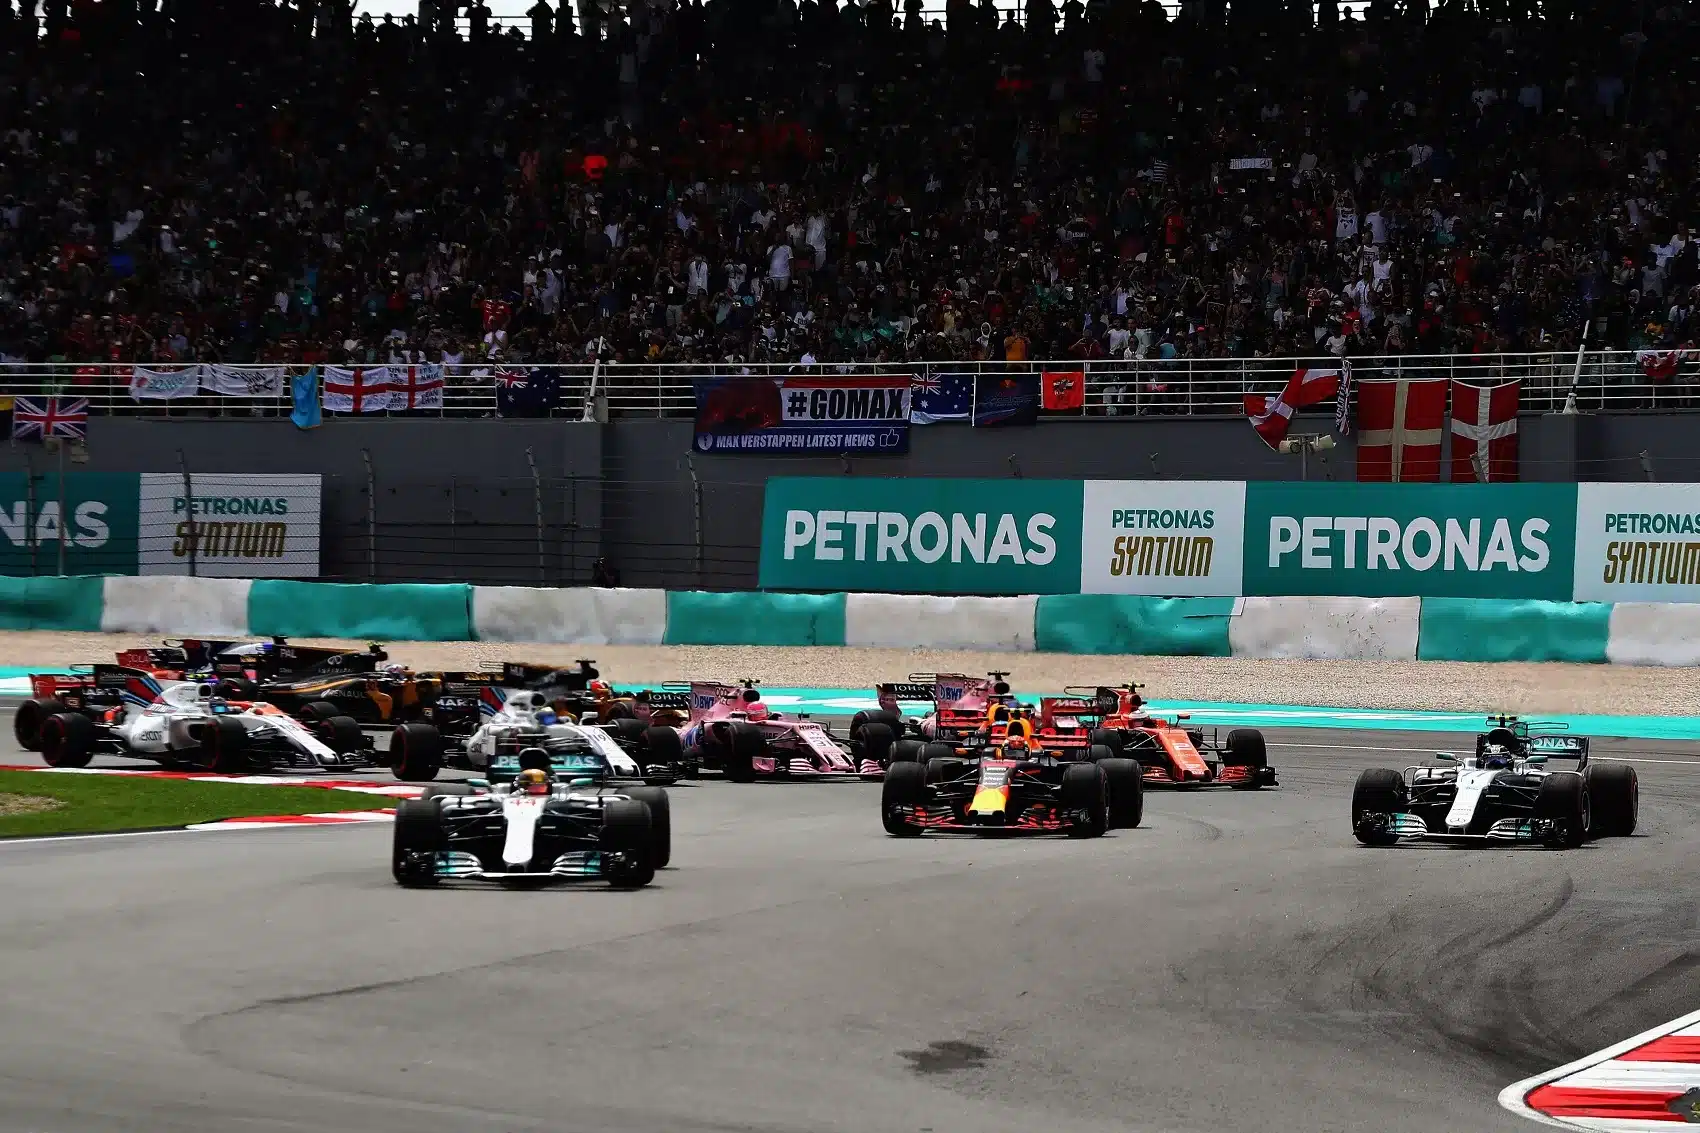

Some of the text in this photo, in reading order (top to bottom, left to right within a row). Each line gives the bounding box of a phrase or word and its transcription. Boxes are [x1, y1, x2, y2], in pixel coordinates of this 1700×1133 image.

[787, 389, 904, 419] #GOMAX
[716, 434, 876, 448] MAX VERSTAPPEN LATEST NEWS
[173, 498, 288, 515] PETRONAS
[1113, 510, 1215, 530] PETRONAS
[783, 510, 1057, 566] PETRONAS
[1269, 516, 1550, 573] PETRONAS
[1111, 536, 1213, 577] SYNTIUM
